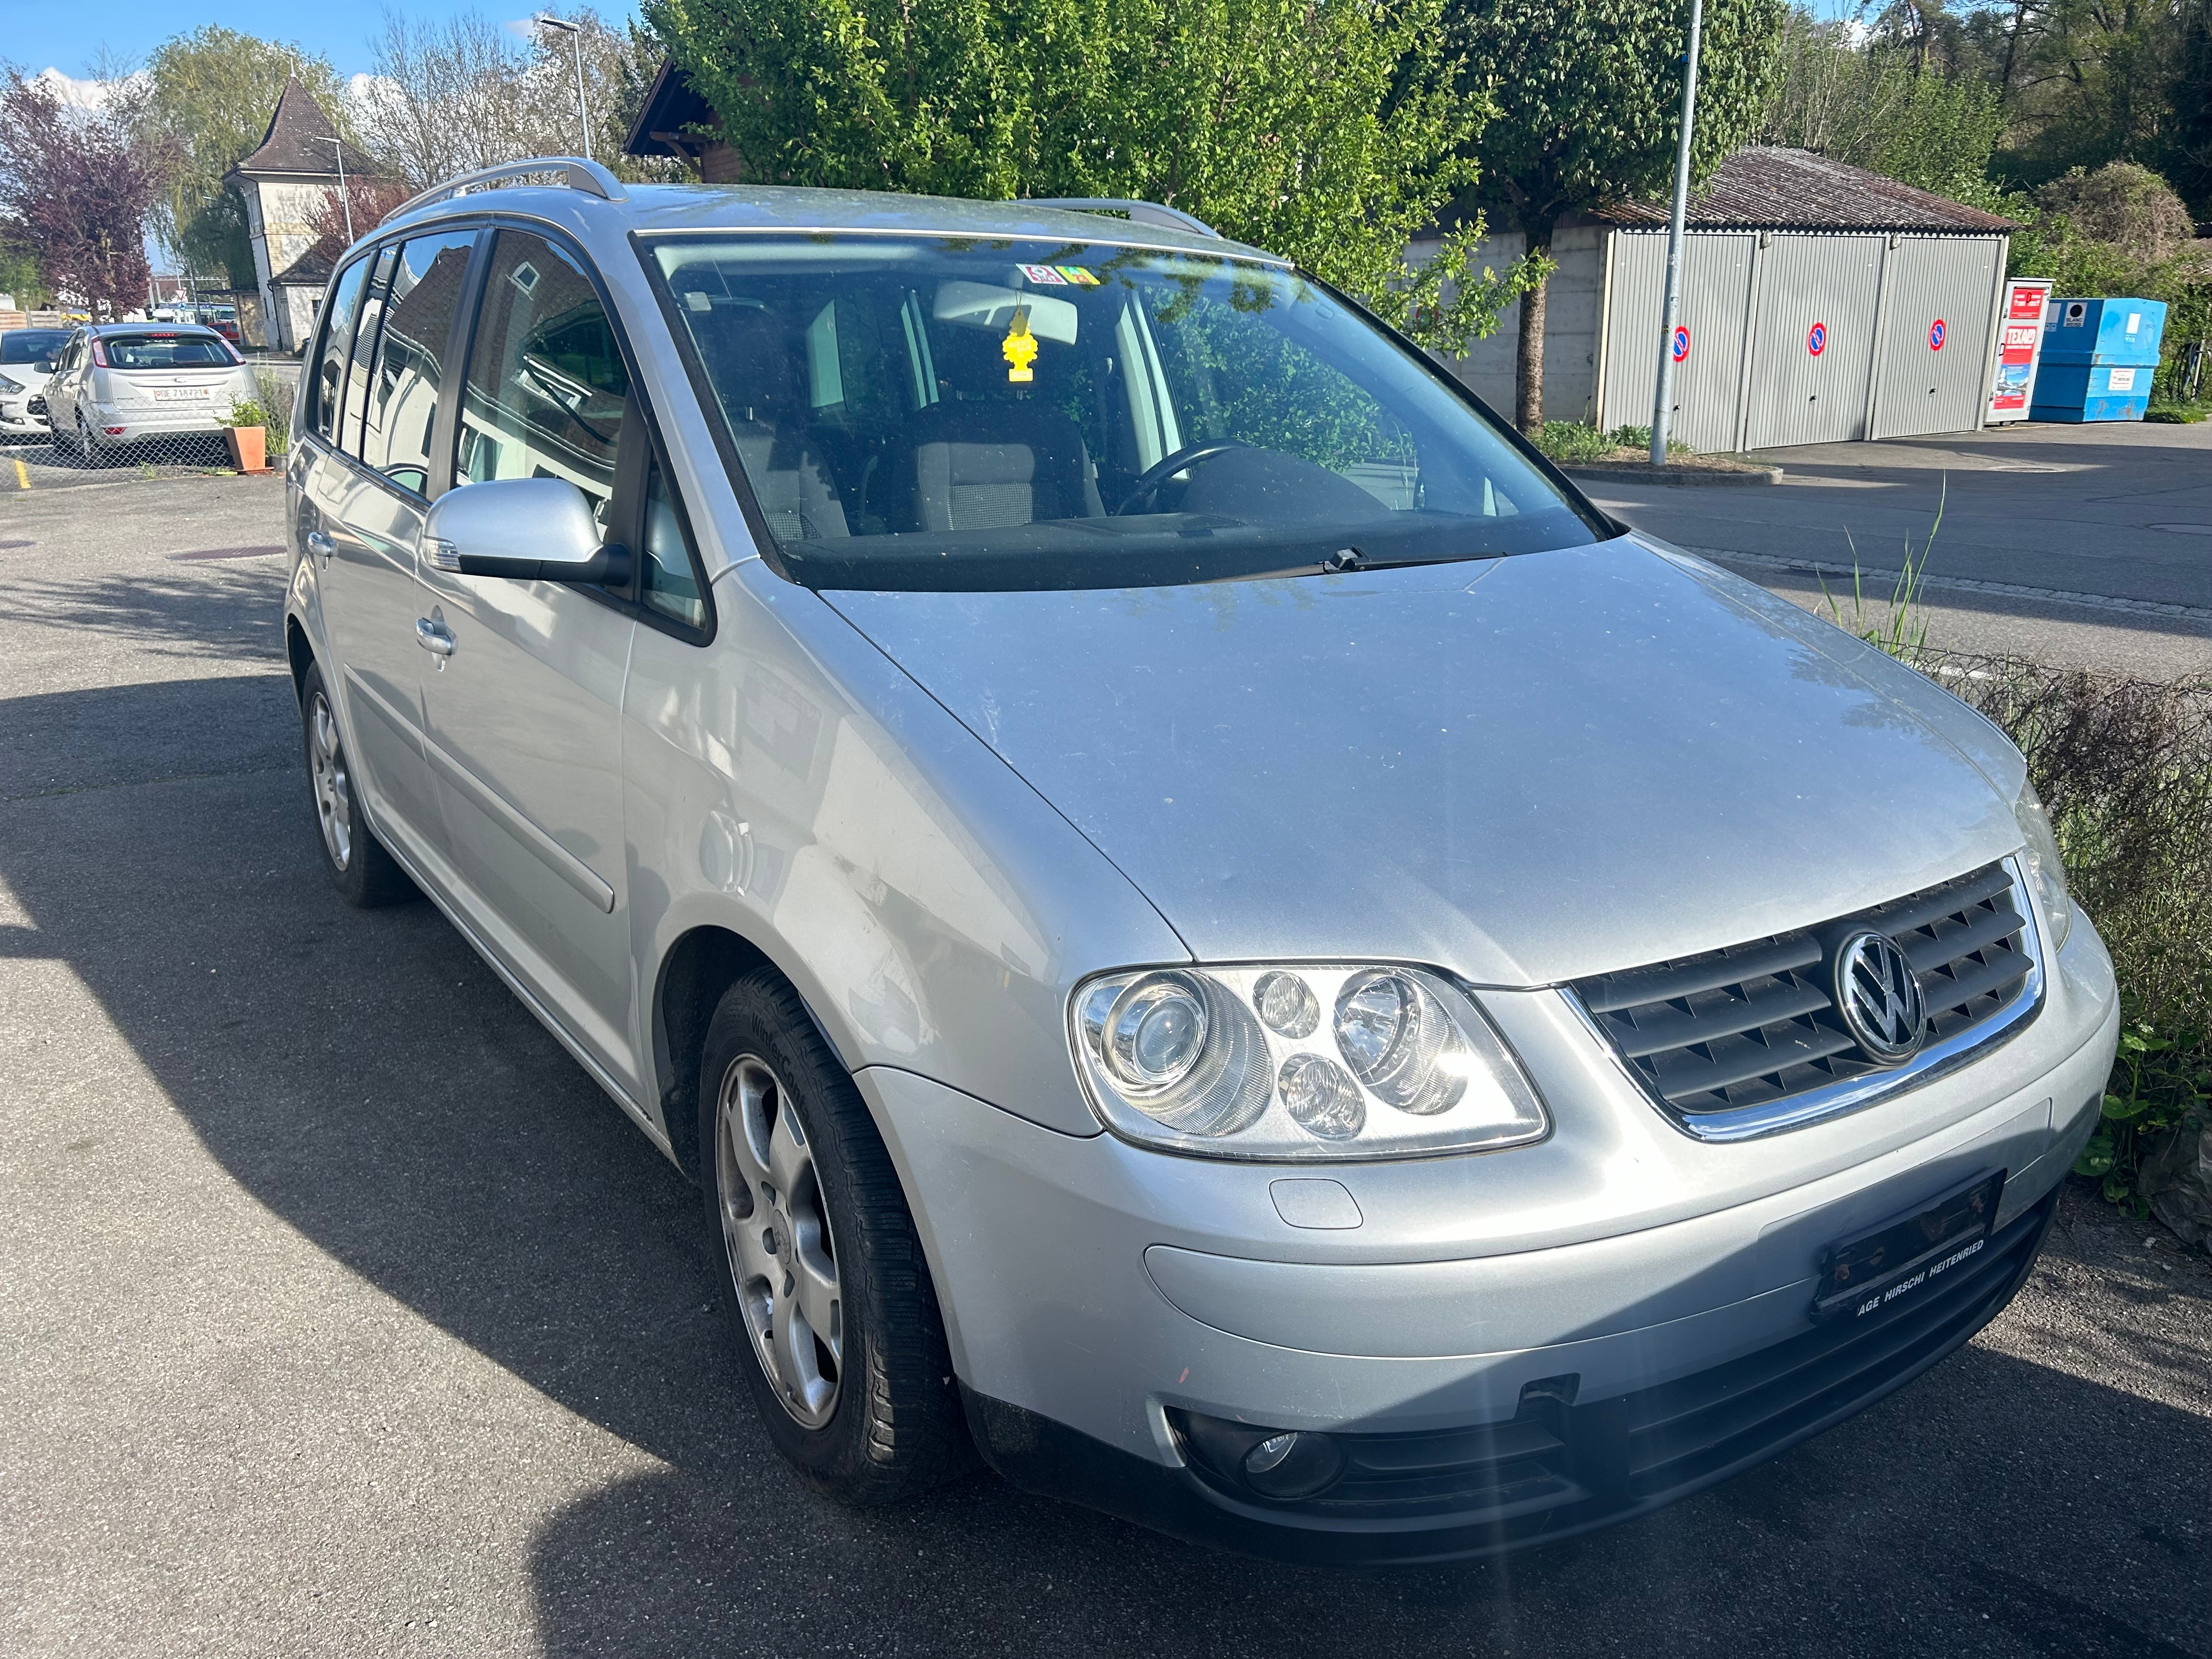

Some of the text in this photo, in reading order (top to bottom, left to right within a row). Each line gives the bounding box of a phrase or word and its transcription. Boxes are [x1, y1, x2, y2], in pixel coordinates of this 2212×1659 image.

[2007, 328, 2037, 345] TEXAID
[1843, 935, 1922, 1052] VW
[1884, 1271, 1926, 1302] HIRSCHI
[1928, 1239, 1984, 1278] HEITENRIED
